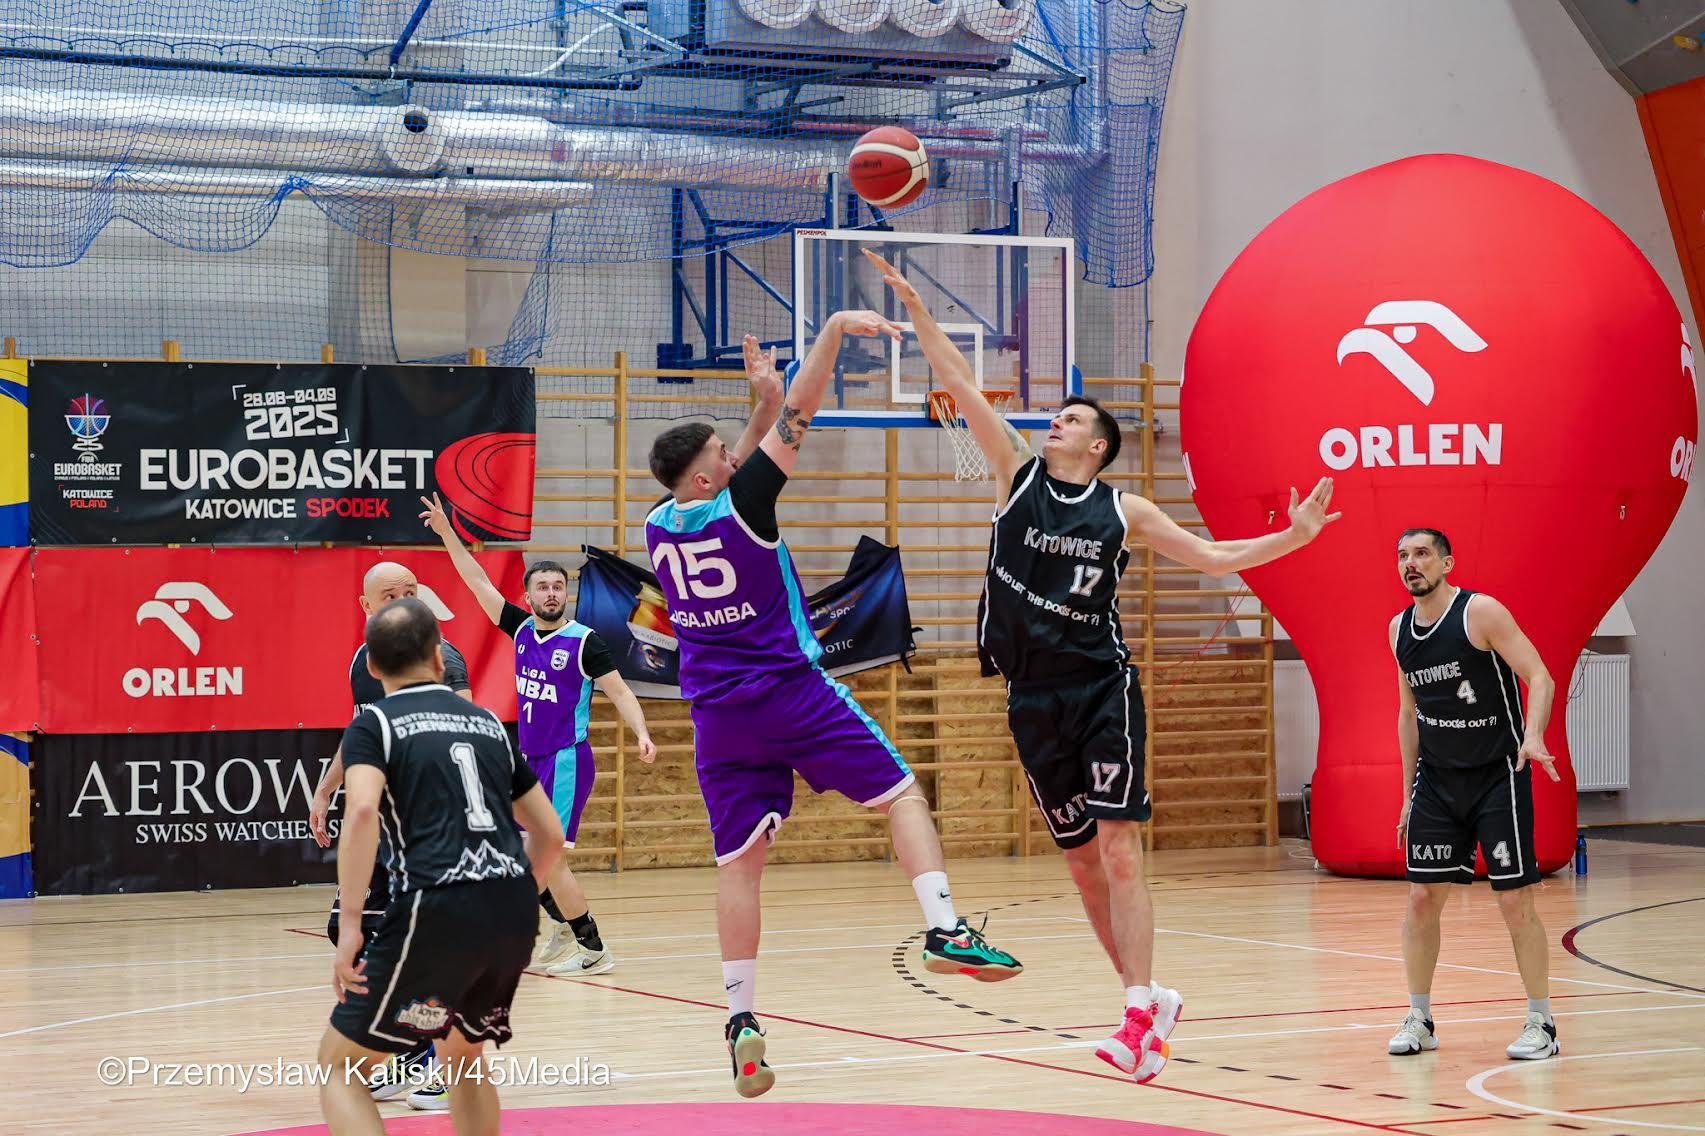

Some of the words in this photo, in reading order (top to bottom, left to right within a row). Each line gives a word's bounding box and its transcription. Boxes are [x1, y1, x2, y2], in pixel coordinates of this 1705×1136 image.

[244, 403, 339, 441] 2025
[1318, 423, 1503, 471] ORLEN
[54, 462, 122, 476] EUROBASKET
[140, 448, 434, 491] EUROBASKET
[62, 489, 114, 499] KATOWICE
[69, 499, 108, 509] POLAND
[185, 498, 298, 520] KATOWICE
[306, 497, 391, 519] SPODEK
[1023, 526, 1103, 560] KATOWICE
[652, 537, 737, 600] 15
[1069, 564, 1104, 597] 17
[995, 565, 1013, 584] WHO
[1010, 579, 1027, 595] LET
[1026, 590, 1045, 606] THE
[122, 666, 243, 698] ORLEN
[521, 665, 547, 681] LIGA
[515, 674, 558, 703] MBA
[1457, 679, 1478, 705] 4
[522, 701, 533, 724] 1
[450, 742, 498, 831] 1
[1091, 761, 1121, 793] 17
[135, 823, 208, 844] SWISS
[1412, 844, 1453, 861] KATO
[1491, 840, 1512, 868] 4
